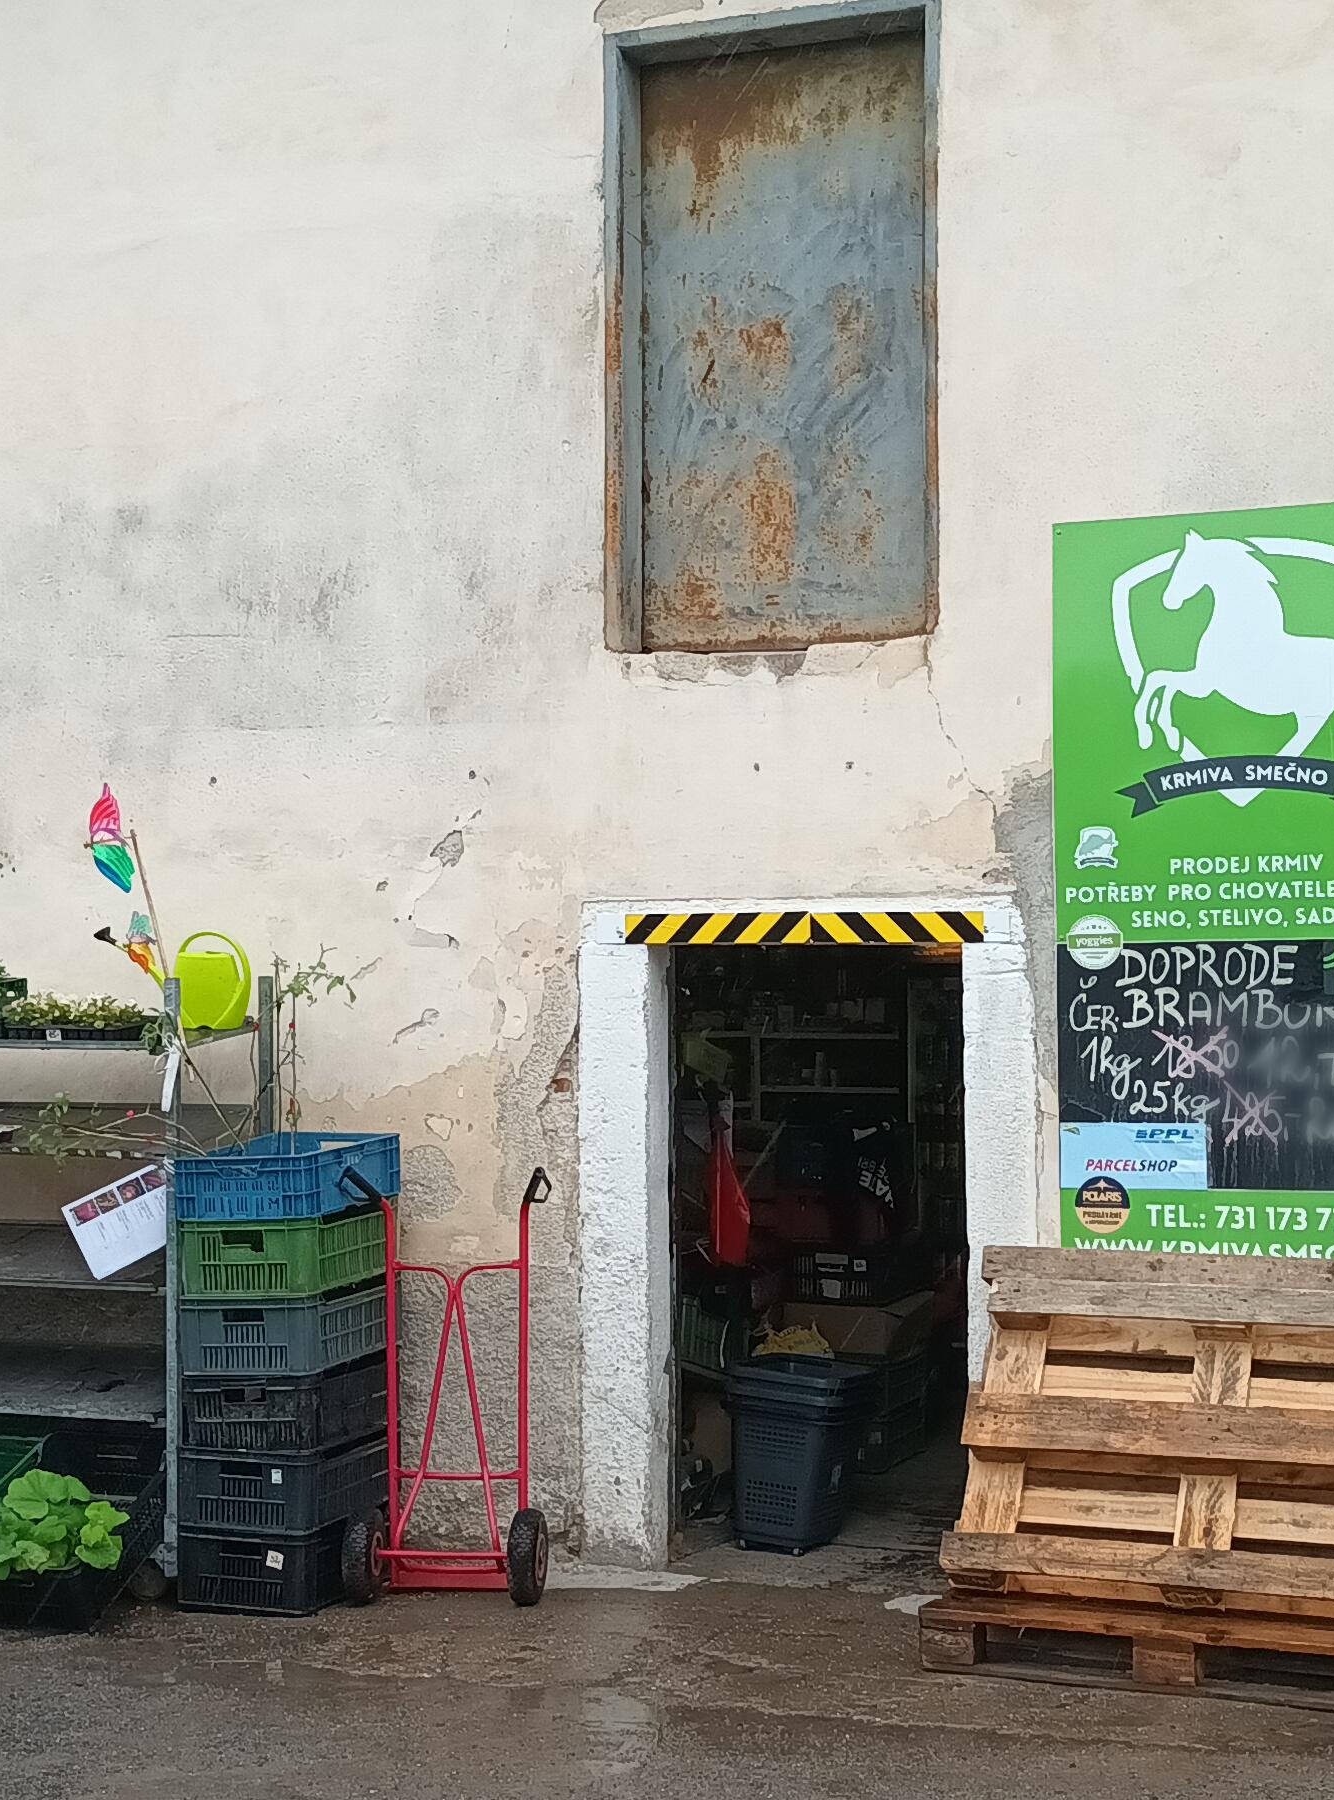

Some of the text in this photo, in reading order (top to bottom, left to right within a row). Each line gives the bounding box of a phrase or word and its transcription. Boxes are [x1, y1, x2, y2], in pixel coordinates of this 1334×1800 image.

[1160, 762, 1328, 791] KRMIVA SMEČNO
[1170, 854, 1324, 875] PRODEJ KRMIV
[1065, 882, 1157, 904] POTŘEBY
[1168, 883, 1212, 902] PRO
[1131, 910, 1192, 929] SENO,
[1198, 908, 1289, 927] STELIVO,
[1075, 935, 1114, 948] yoggies
[1115, 943, 1299, 990] DOPRODE
[1080, 1036, 1143, 1100] 1kg
[1085, 1159, 1178, 1172] PARCELSHOP
[1082, 1190, 1123, 1203] POLARIS
[1146, 1204, 1206, 1228] TEL.:
[1214, 1206, 1255, 1230] 731
[1266, 1206, 1308, 1230] 173
